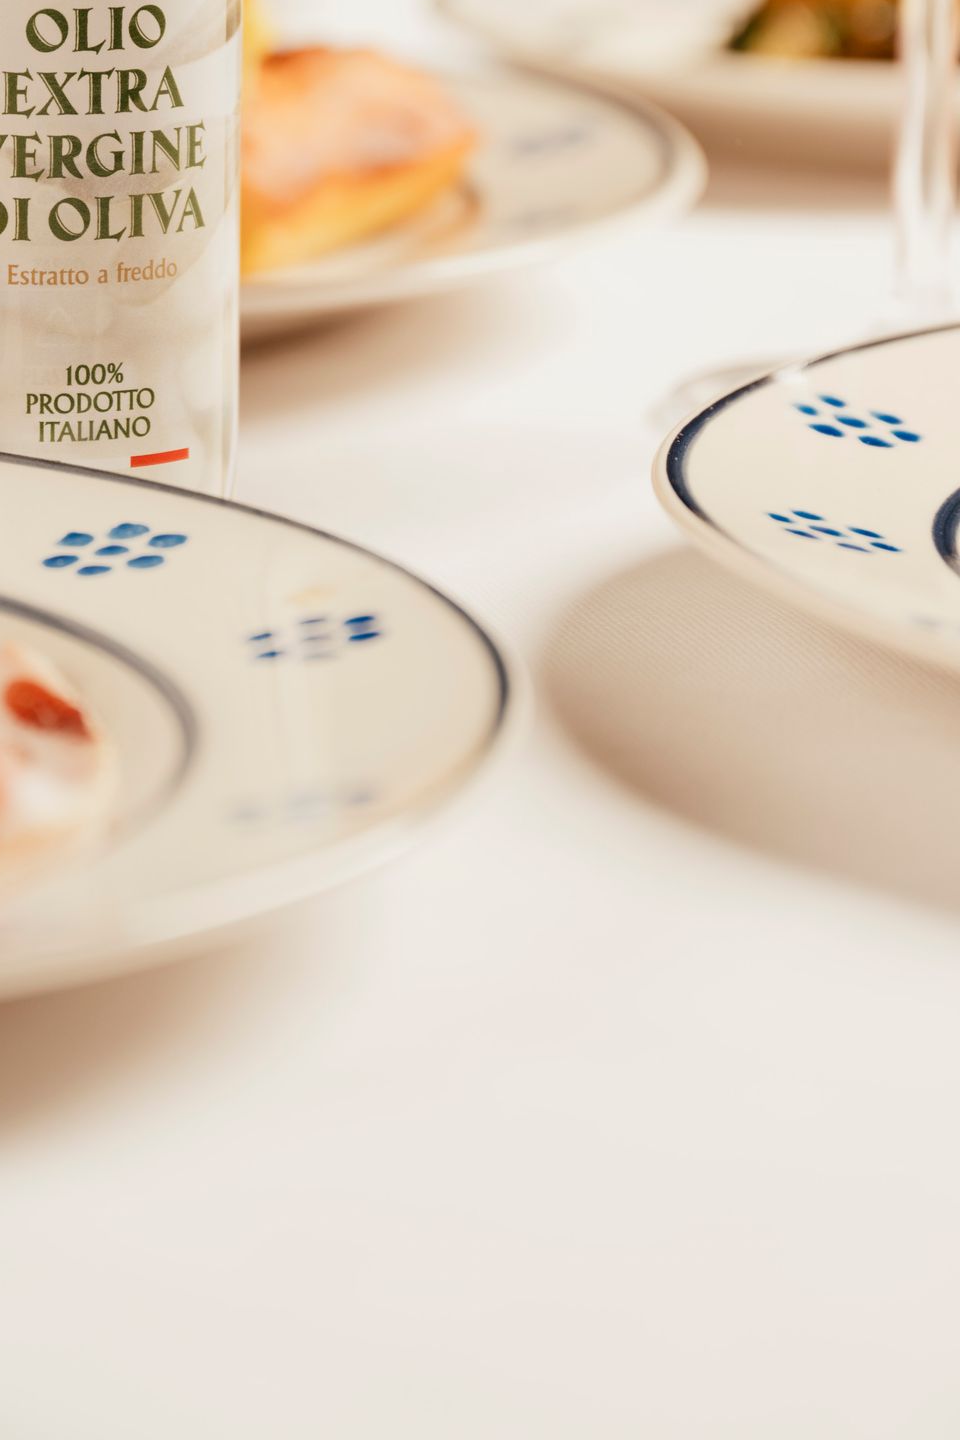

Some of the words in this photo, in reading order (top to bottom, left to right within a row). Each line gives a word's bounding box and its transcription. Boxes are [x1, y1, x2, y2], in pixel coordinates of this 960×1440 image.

[26, 5, 165, 54] OLIO
[2, 66, 183, 118] EXTRA
[48, 187, 205, 242] OLIVA
[8, 264, 89, 285] Estratto
[98, 269, 108, 283] a
[117, 258, 178, 283] freddo
[66, 362, 123, 386] 100%
[26, 388, 154, 414] PRODOTTO
[40, 416, 150, 442] ITALIANO
